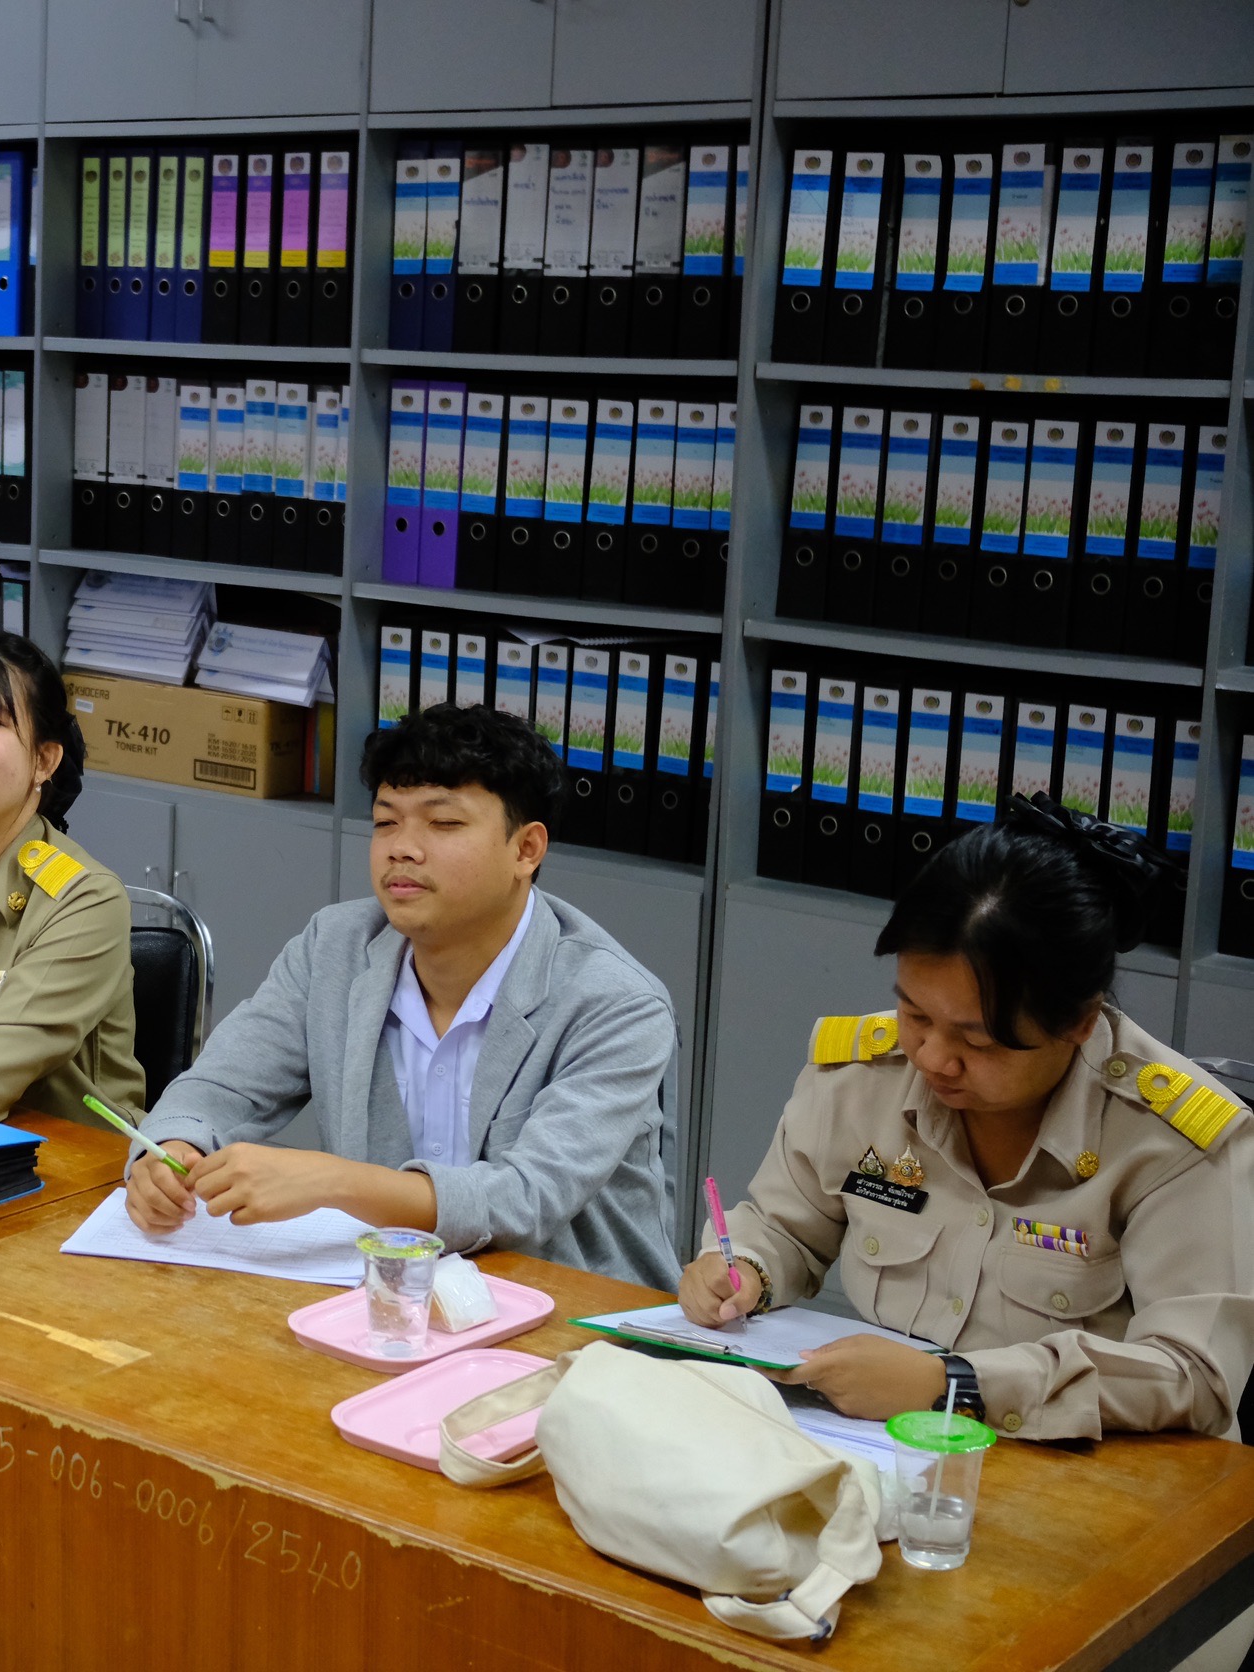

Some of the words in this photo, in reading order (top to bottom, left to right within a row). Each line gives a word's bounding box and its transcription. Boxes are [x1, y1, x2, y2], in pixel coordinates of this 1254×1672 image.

[74, 685, 110, 700] KYOCERA
[105, 719, 171, 745] TK-410
[115, 741, 143, 753] TONER
[144, 746, 158, 756] KIT
